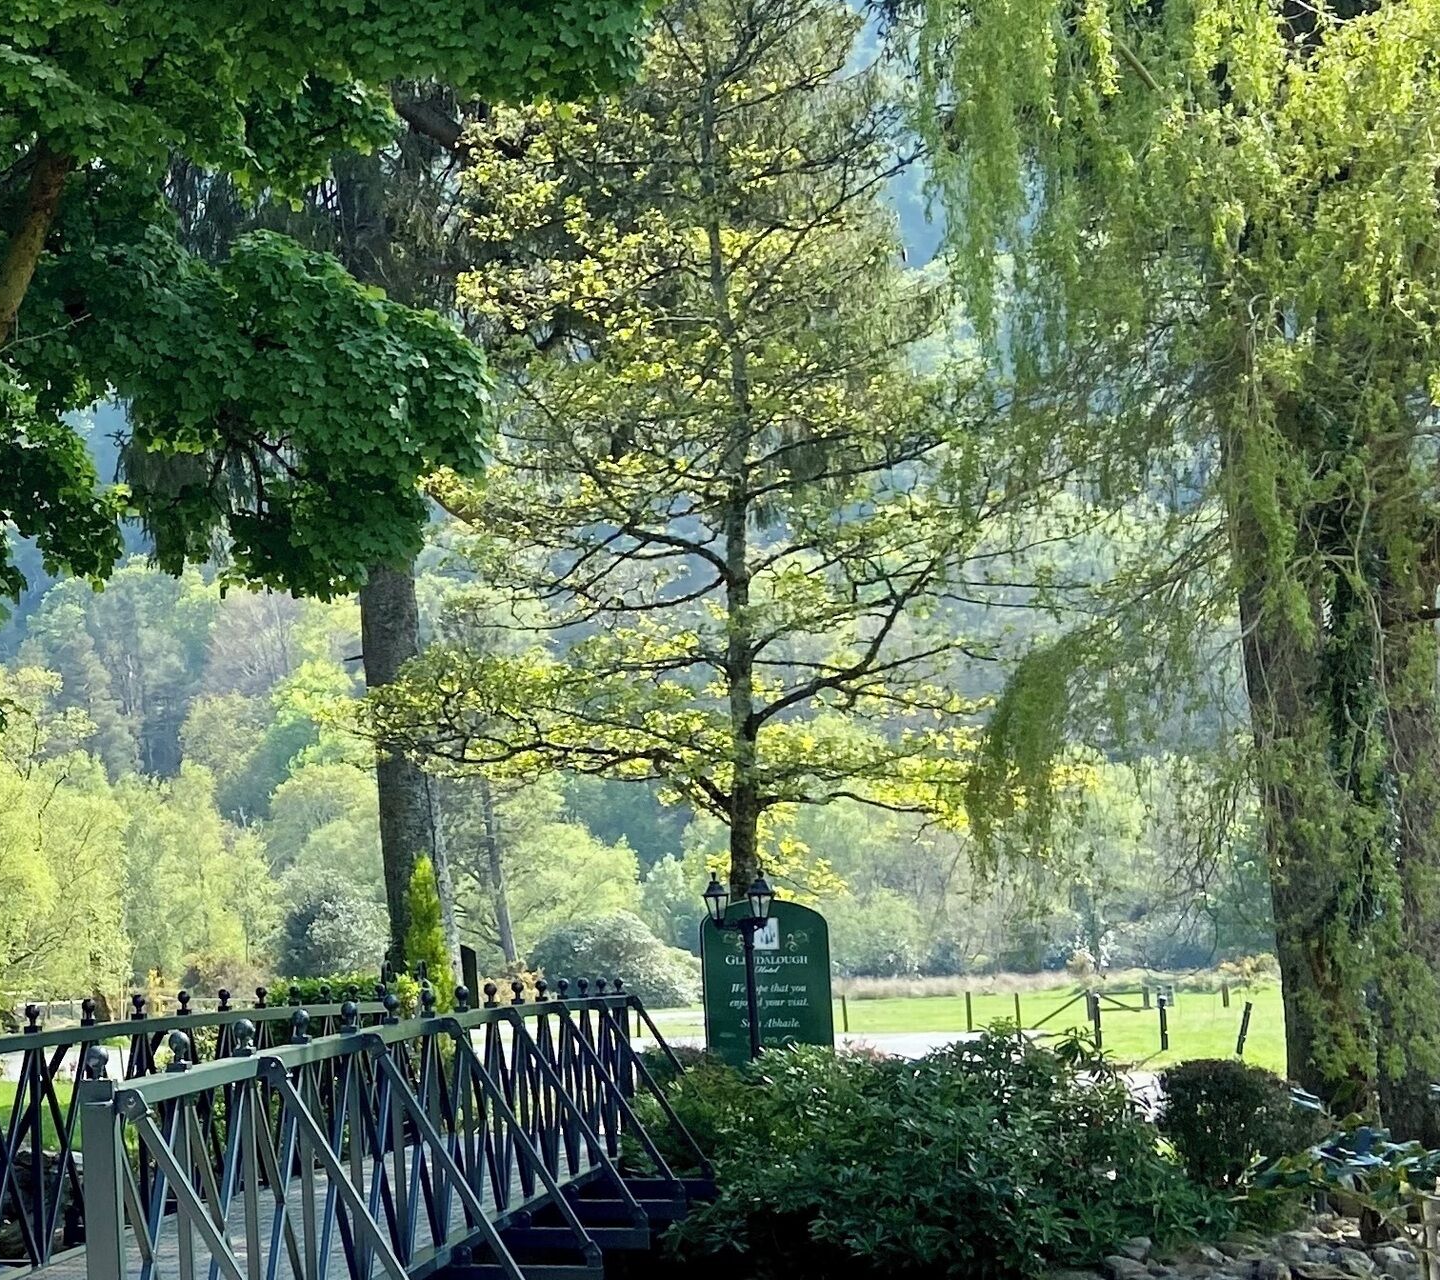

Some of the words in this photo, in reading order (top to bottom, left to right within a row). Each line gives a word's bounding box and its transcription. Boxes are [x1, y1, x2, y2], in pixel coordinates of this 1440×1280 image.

[725, 954, 808, 965] GLDALOUGH
[770, 983, 789, 993] that
[791, 985, 806, 995] you
